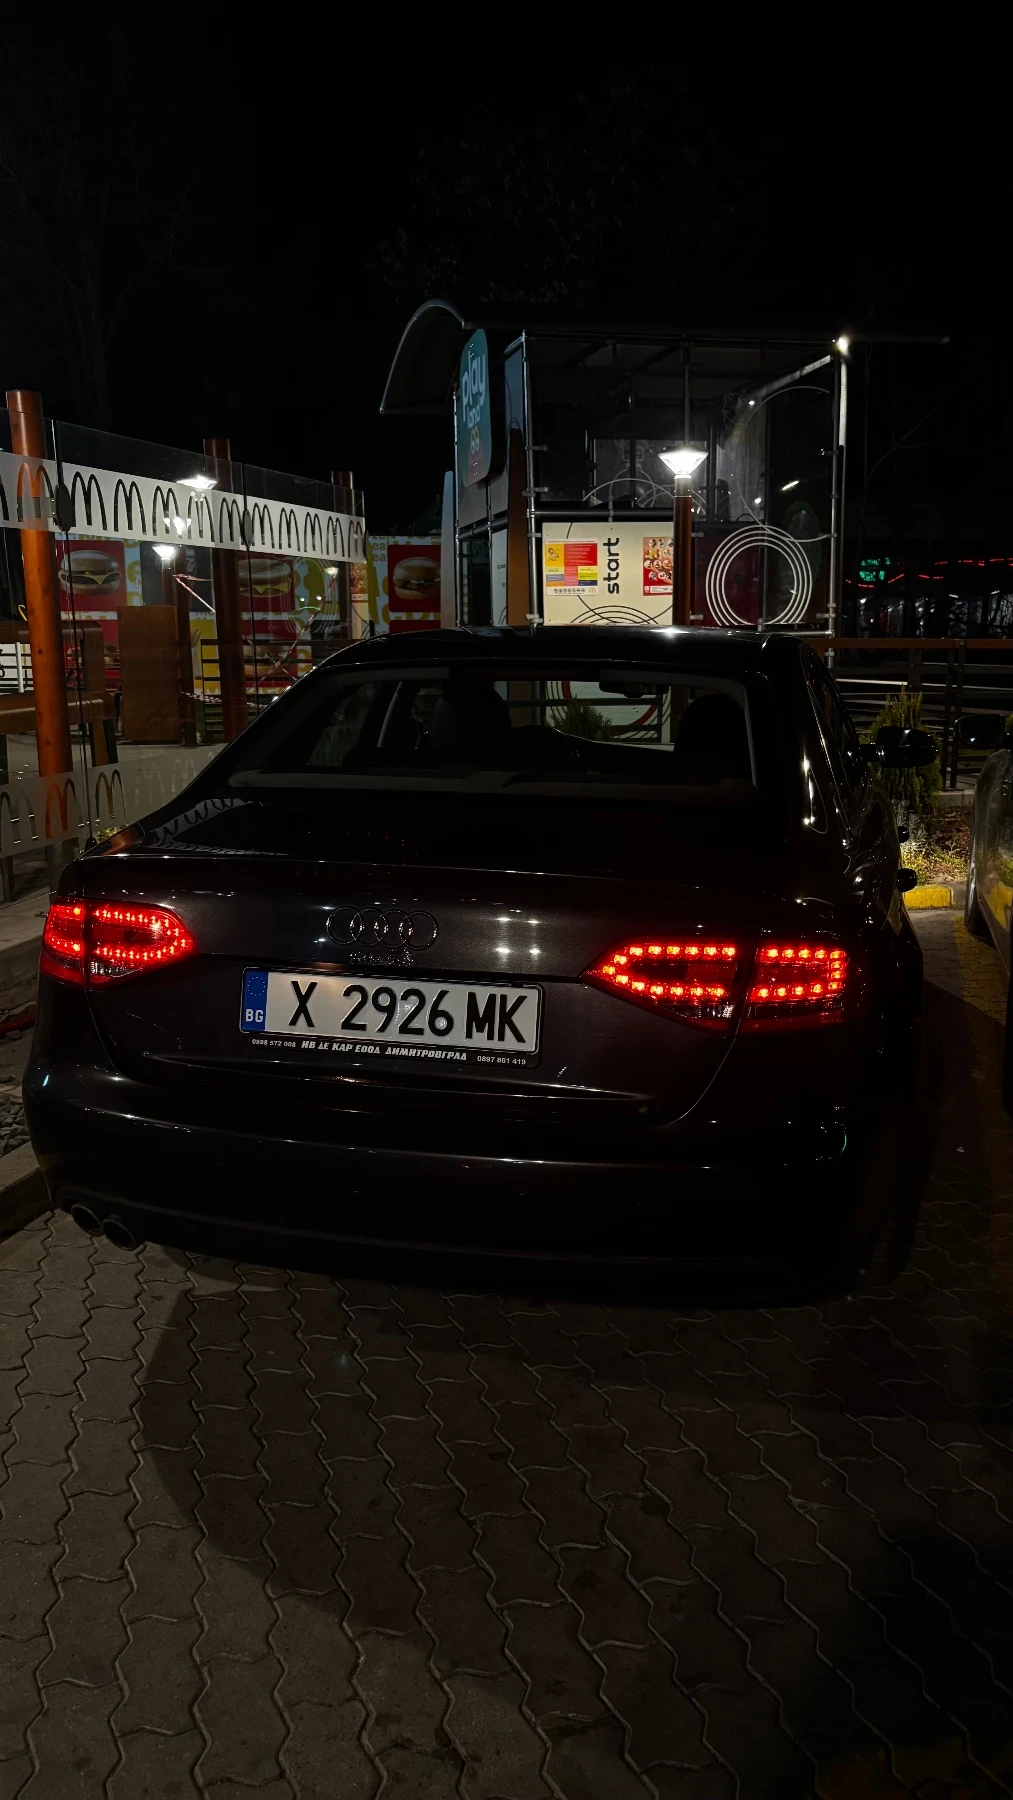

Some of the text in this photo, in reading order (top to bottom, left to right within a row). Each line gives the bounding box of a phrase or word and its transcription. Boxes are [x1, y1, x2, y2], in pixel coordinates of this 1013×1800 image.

[462, 350, 486, 422] play
[602, 537, 620, 595] start
[245, 1008, 264, 1023] BG
[341, 983, 454, 1037] 2926
[465, 991, 528, 1044] MK
[332, 1042, 354, 1052] КАР
[354, 1044, 381, 1054] ЕООД
[385, 1046, 467, 1061] ДИМИТРОВГРАД
